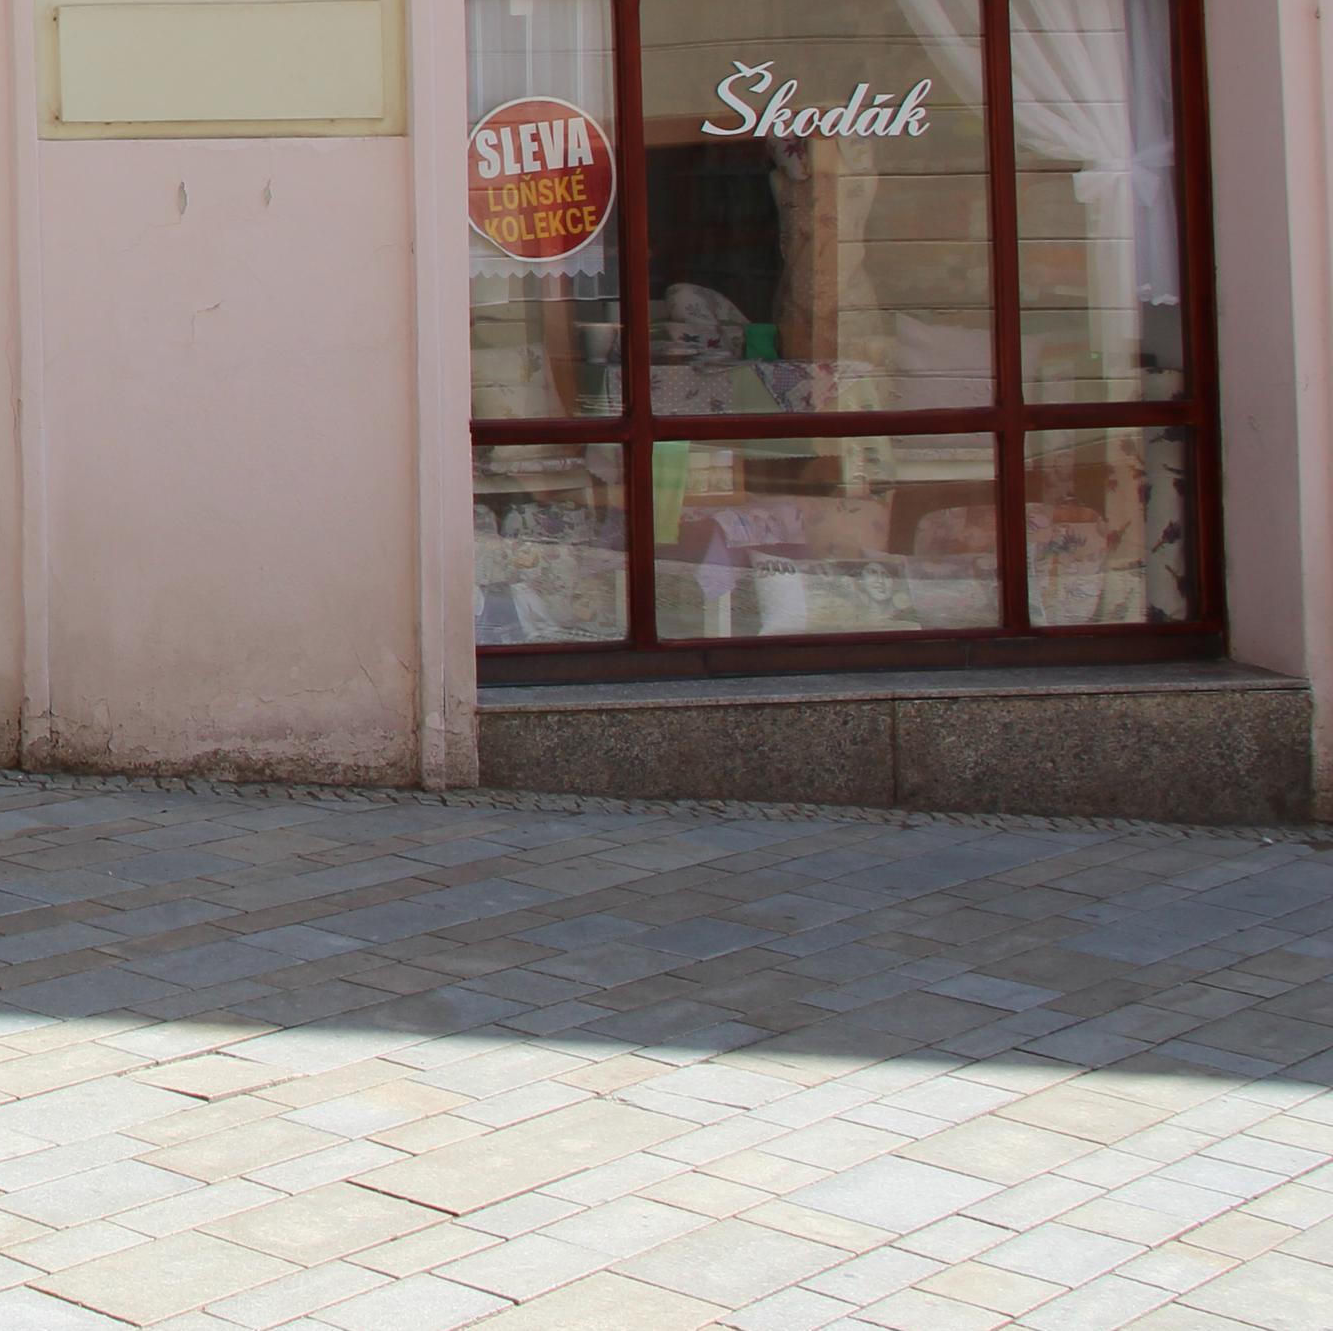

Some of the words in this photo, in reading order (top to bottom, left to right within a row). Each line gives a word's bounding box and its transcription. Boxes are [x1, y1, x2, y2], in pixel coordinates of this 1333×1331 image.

[700, 60, 934, 138] Škodák
[475, 116, 592, 181] SLEVA
[487, 169, 588, 213] LOŇSKÉ
[483, 206, 598, 244] KOLEKCE
